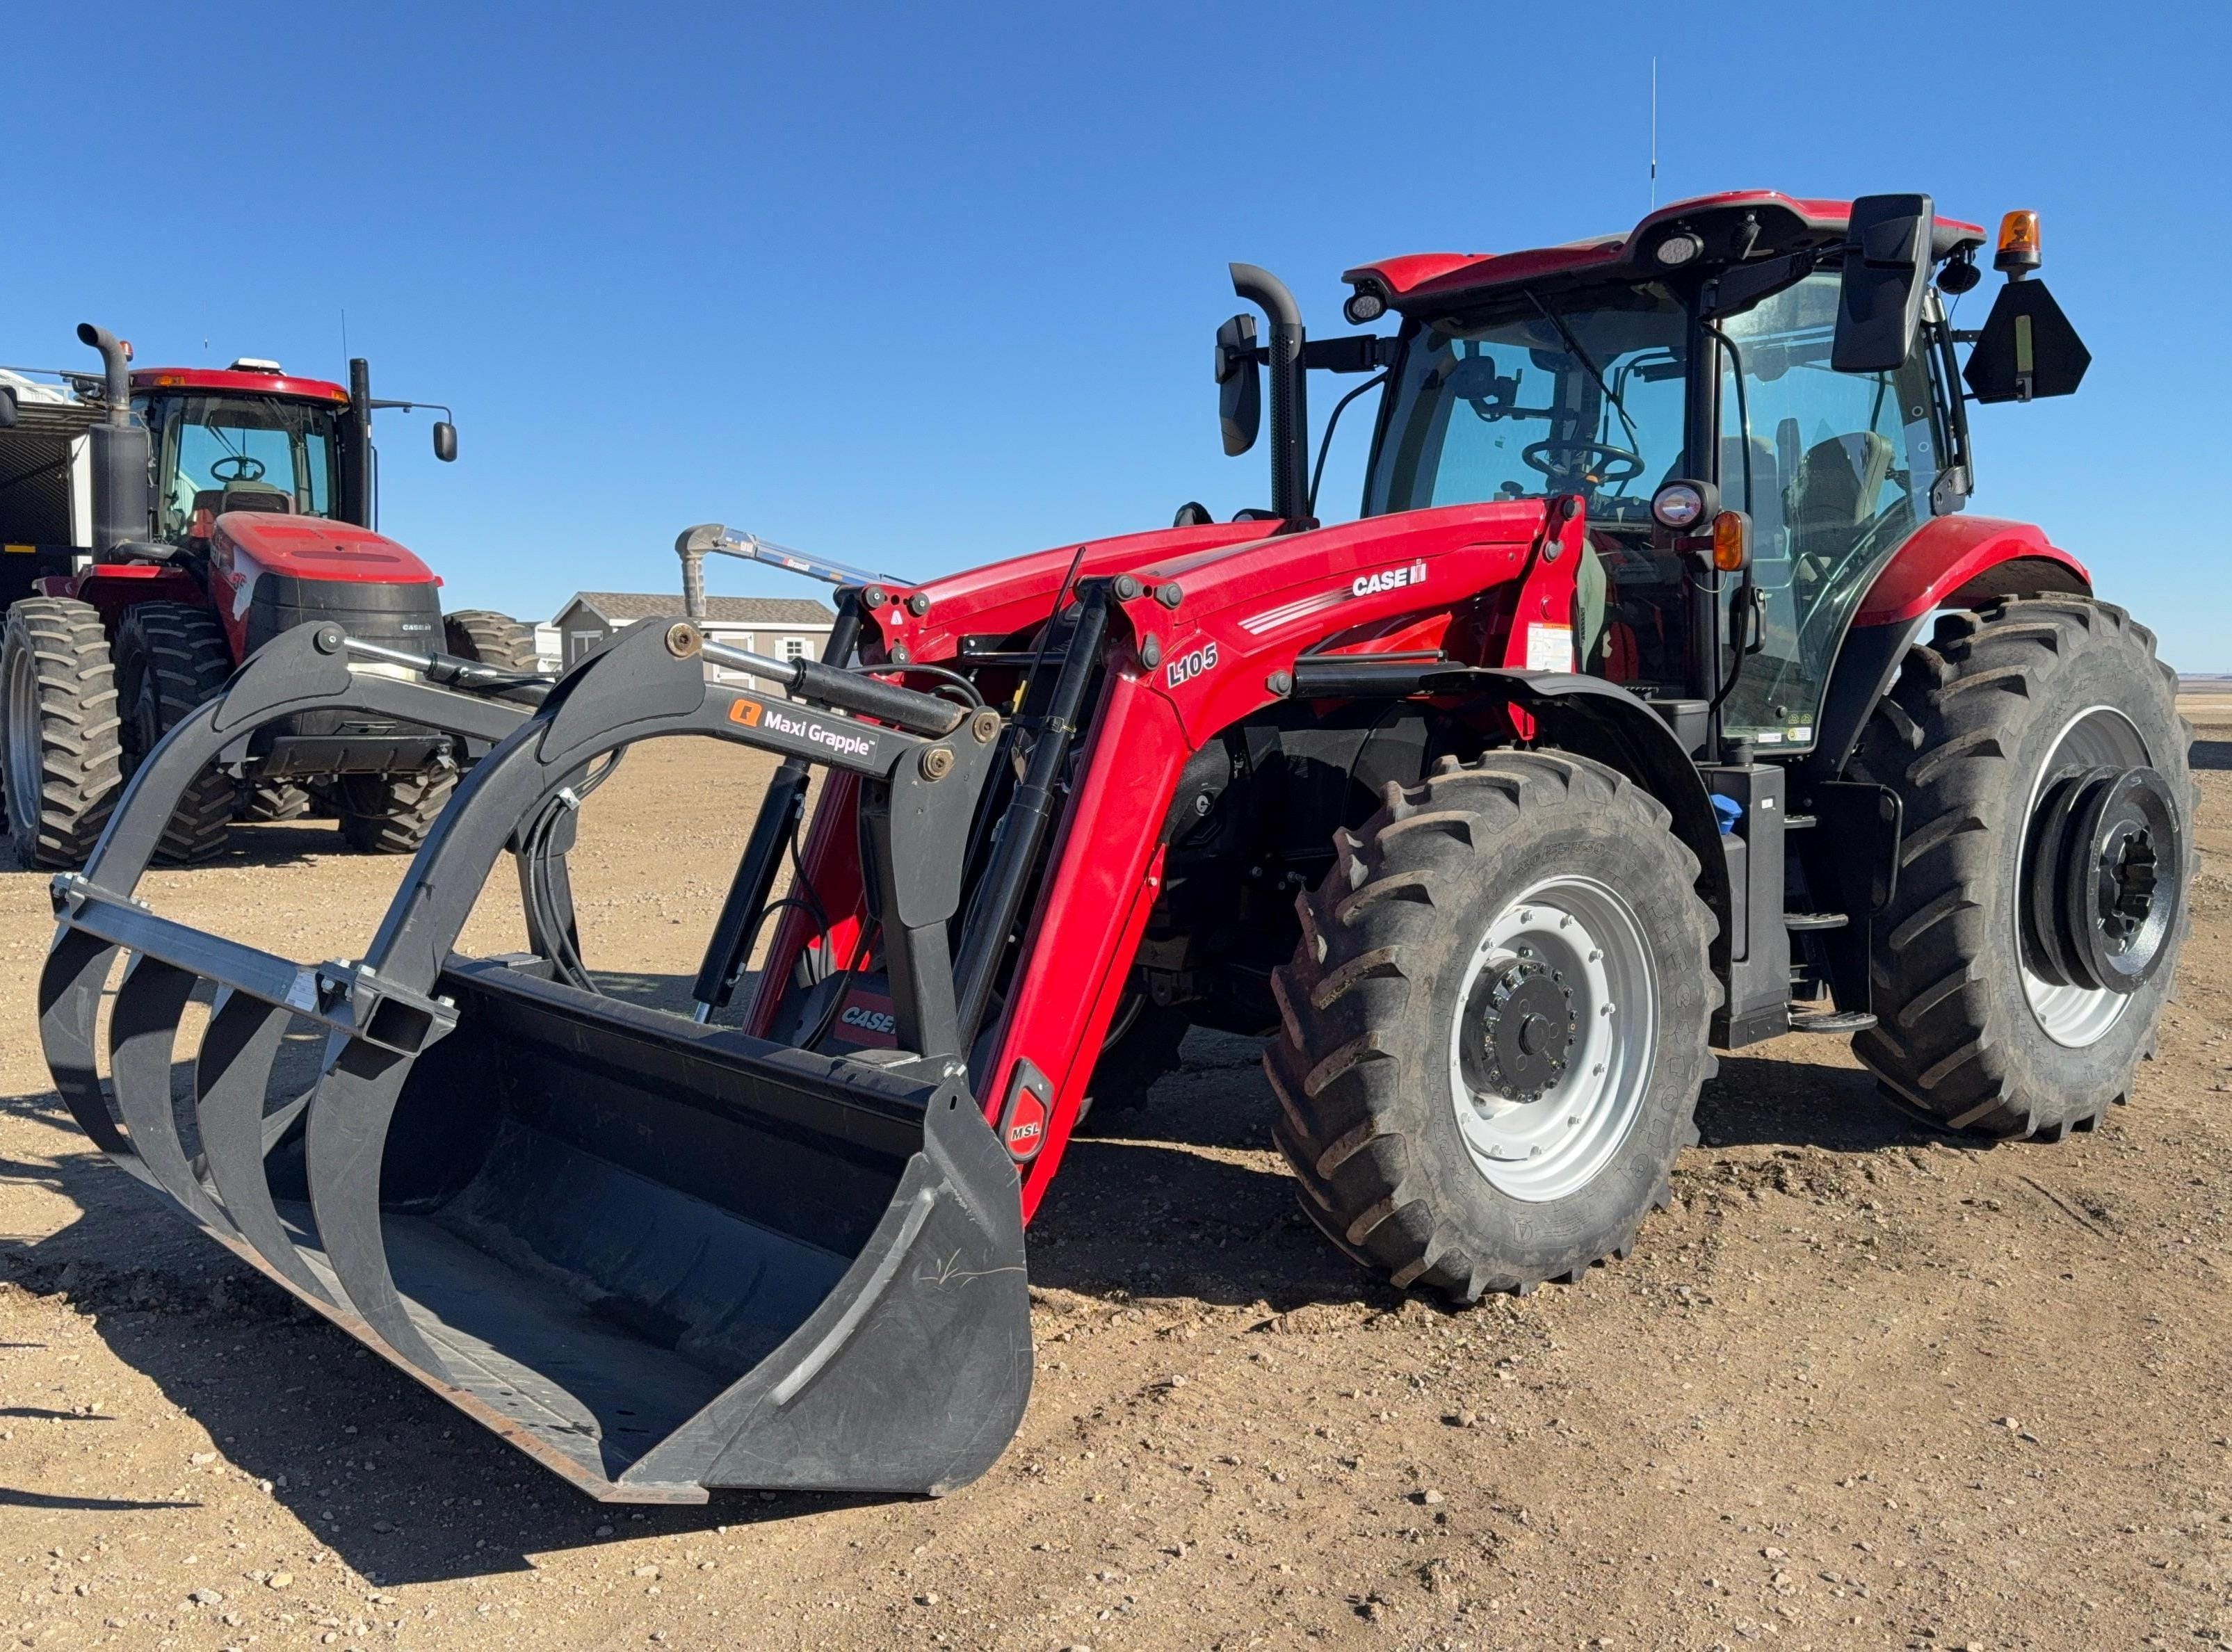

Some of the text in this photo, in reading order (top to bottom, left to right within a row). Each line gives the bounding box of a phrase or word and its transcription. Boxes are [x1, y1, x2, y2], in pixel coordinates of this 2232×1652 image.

[1352, 567, 1408, 597] CASE
[1167, 641, 1218, 689] L105
[764, 711, 807, 737] Maxi
[841, 1006, 895, 1033] CASE
[1010, 1122, 1040, 1142] MSL
